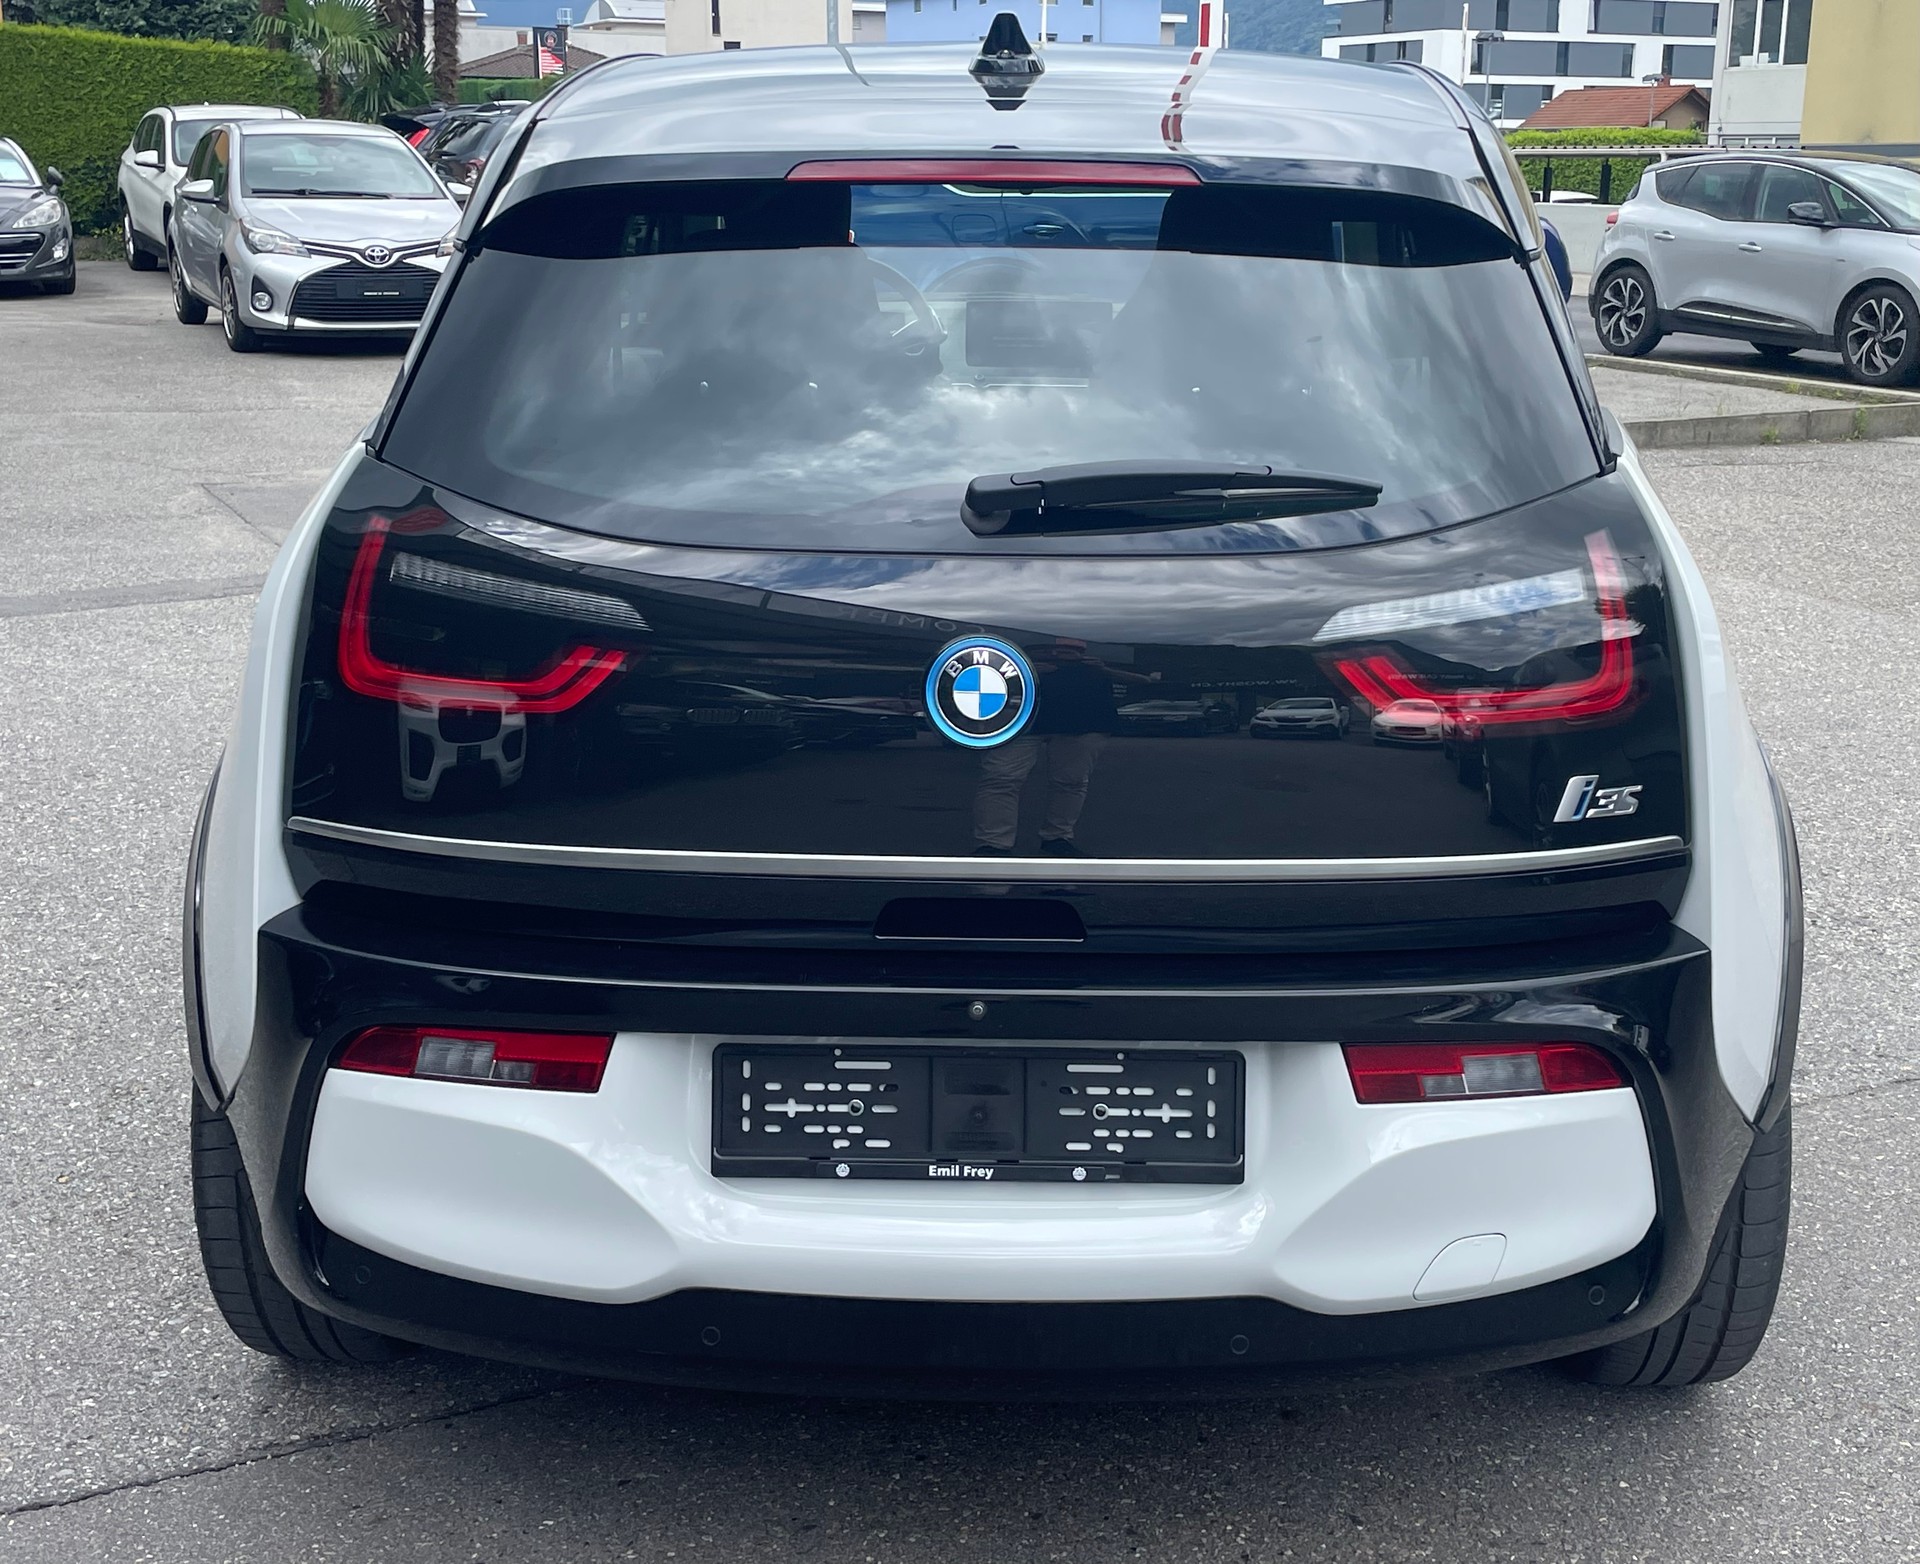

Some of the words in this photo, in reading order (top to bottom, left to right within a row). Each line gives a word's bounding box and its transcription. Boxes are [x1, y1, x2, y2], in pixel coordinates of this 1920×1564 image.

[946, 650, 1018, 679] BMW
[928, 1164, 959, 1177] Emil
[963, 1165, 994, 1179] Frey
